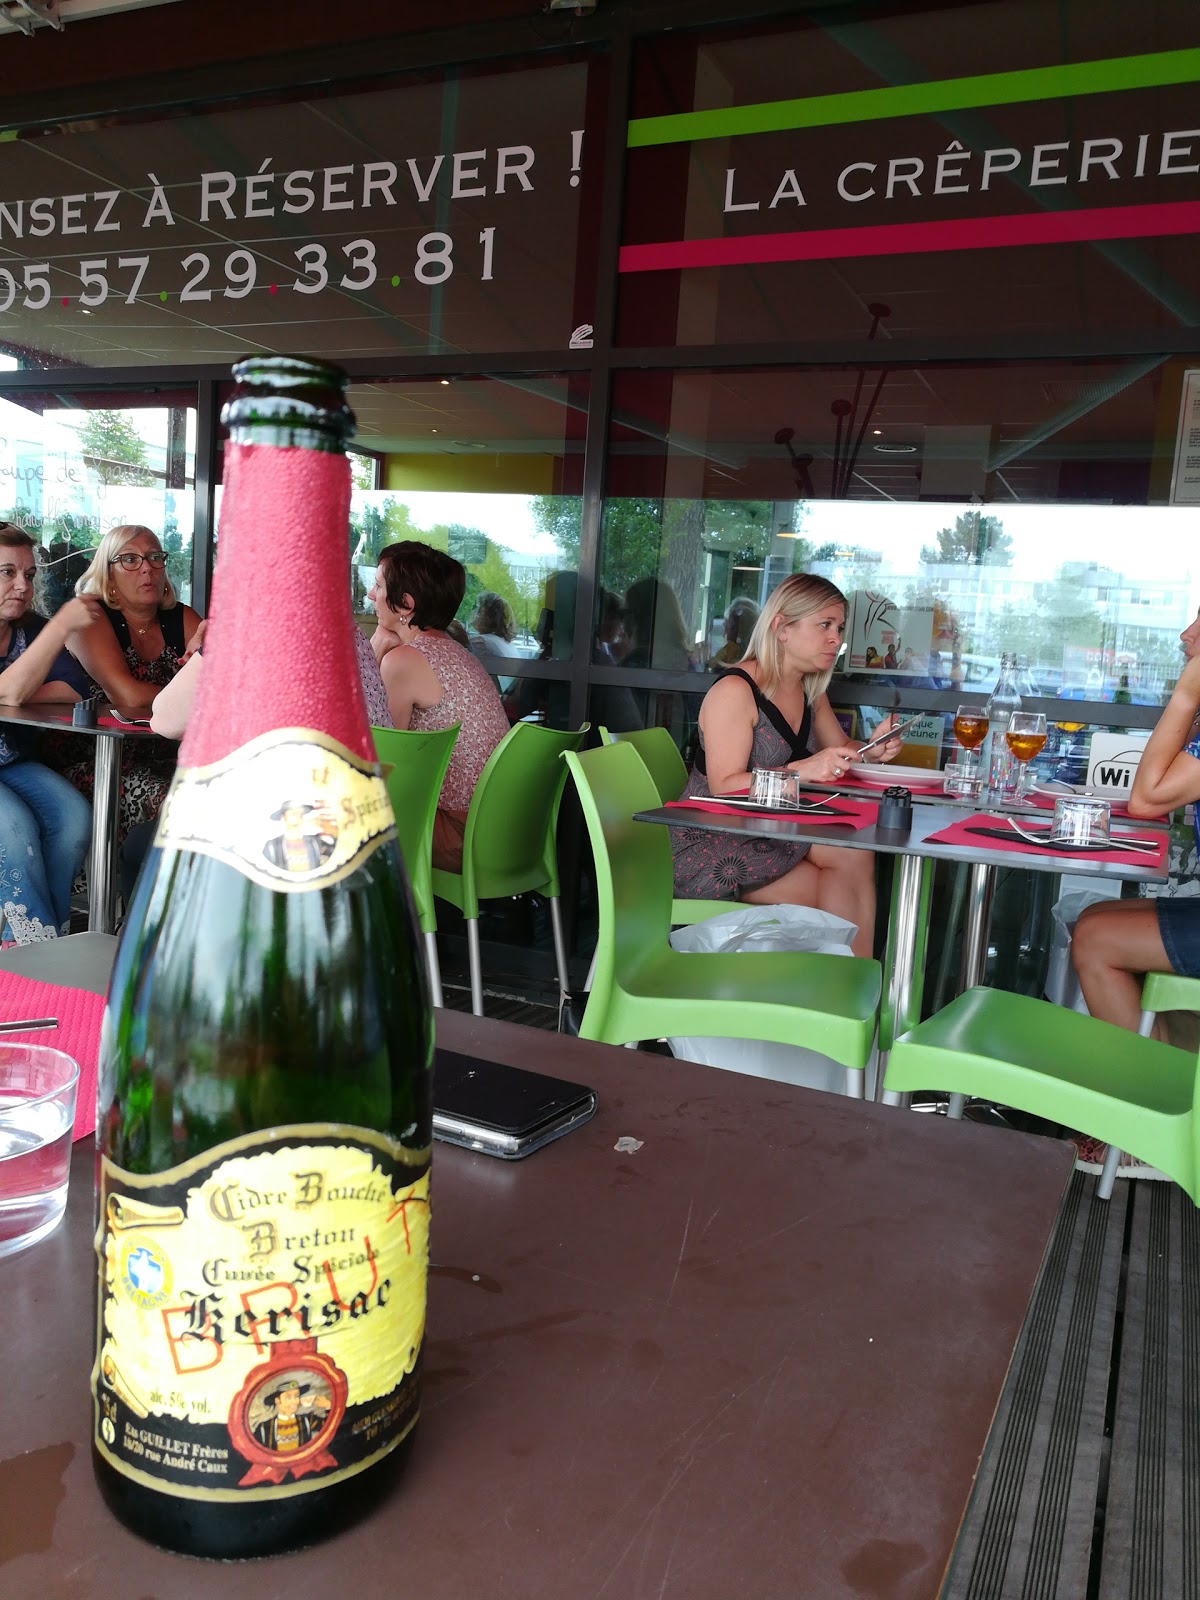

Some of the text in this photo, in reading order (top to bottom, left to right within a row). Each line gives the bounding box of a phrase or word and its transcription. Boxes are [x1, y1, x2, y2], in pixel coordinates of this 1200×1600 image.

[0, 190, 121, 239] NSEZ
[142, 173, 175, 227] À
[200, 145, 535, 221] RÉSERVER
[723, 129, 1200, 213] LA CRÊPERIE
[887, 788, 907, 797] 52
[210, 1172, 388, 1222] Cidre Bouché
[242, 1221, 355, 1259] Breton
[161, 1187, 417, 1375] BRUT
[202, 1257, 276, 1287] Cuvée
[180, 1279, 393, 1346] Kerisac
[140, 1430, 191, 1456] GUILLET
[192, 1443, 229, 1459] Frères
[145, 1449, 161, 1463] rue
[162, 1453, 196, 1471] André
[198, 1459, 228, 1474] Caux
